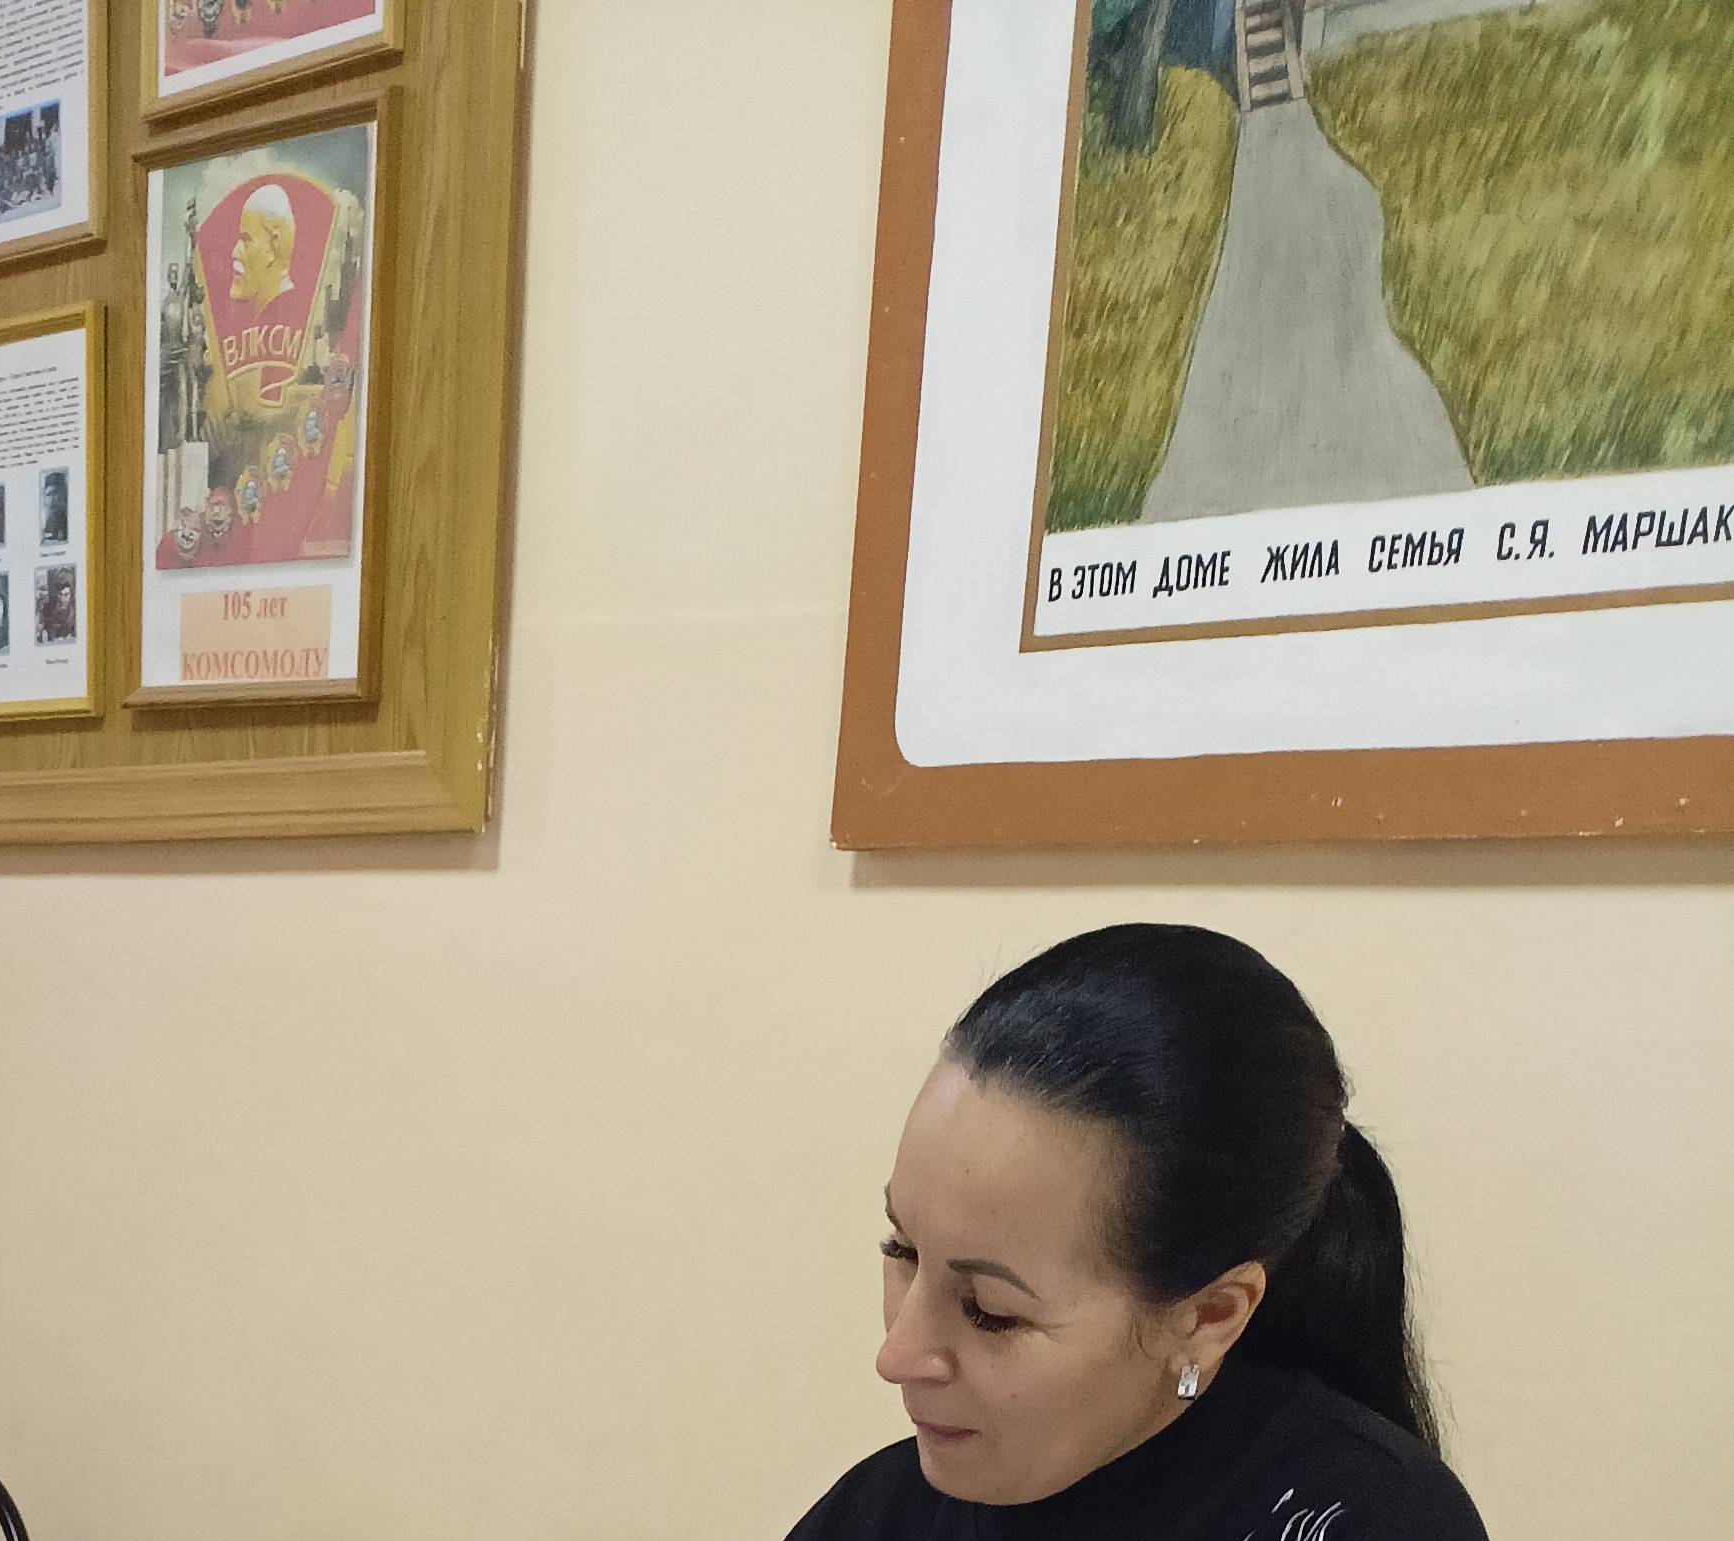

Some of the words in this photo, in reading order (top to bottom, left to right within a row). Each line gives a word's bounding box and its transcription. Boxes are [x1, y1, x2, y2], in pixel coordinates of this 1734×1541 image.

[222, 323, 304, 368] ВЛКСМ
[1048, 567, 1063, 602] В
[1071, 559, 1138, 600] ЭТОМ
[1152, 550, 1232, 599] ДОМЕ
[1260, 539, 1341, 584] ЖИЛА
[1367, 527, 1466, 574] СЕМЬЯ
[1496, 518, 1556, 561] С.Я.
[222, 590, 252, 621] 105
[256, 596, 288, 620] лет
[181, 647, 329, 682] КОМСОМОЛУ
